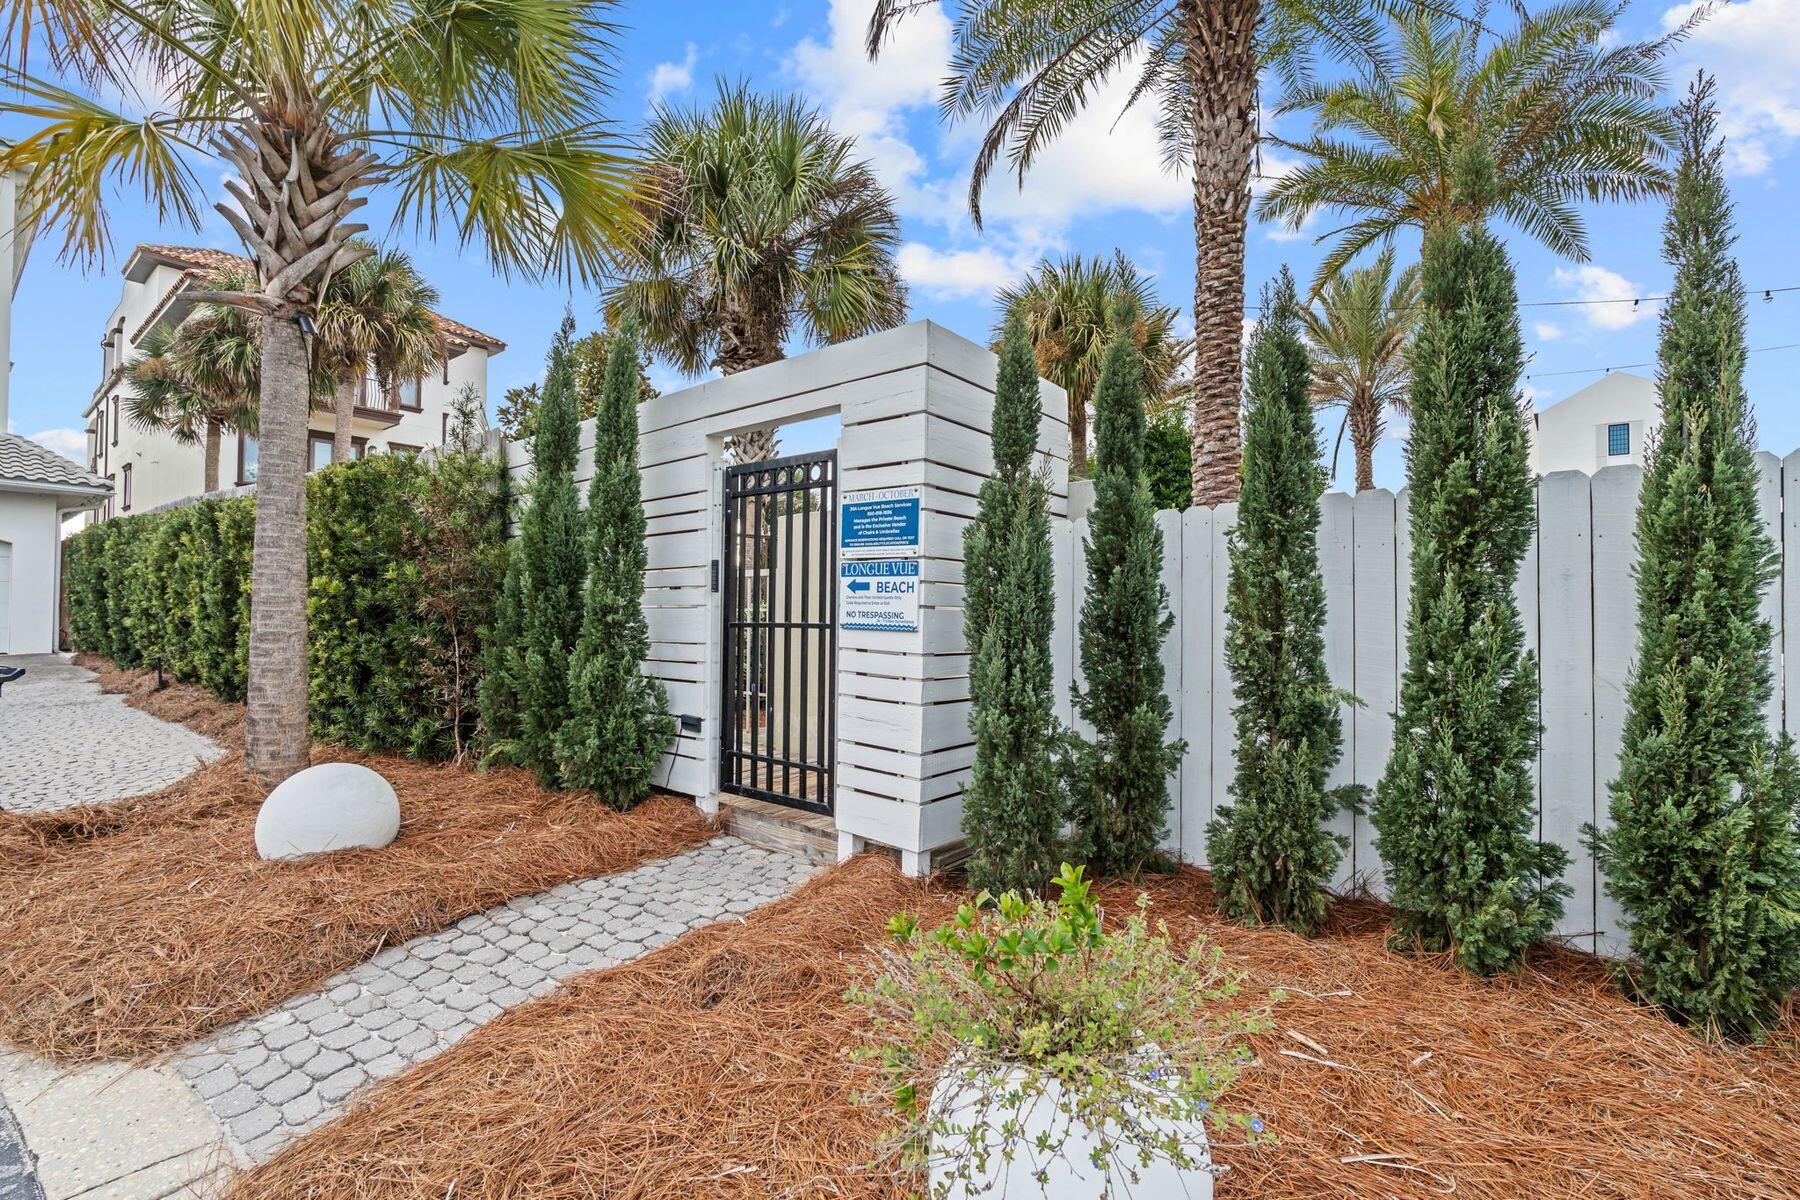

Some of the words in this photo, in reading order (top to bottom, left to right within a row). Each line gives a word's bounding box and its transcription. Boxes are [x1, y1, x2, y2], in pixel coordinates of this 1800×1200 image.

[849, 492, 874, 502] MARCH
[878, 488, 914, 500] OCTOBER
[845, 562, 890, 575] LONGUE
[892, 562, 915, 574] VUE
[877, 581, 914, 593] BEACH
[858, 611, 904, 619] TRESPASSING
